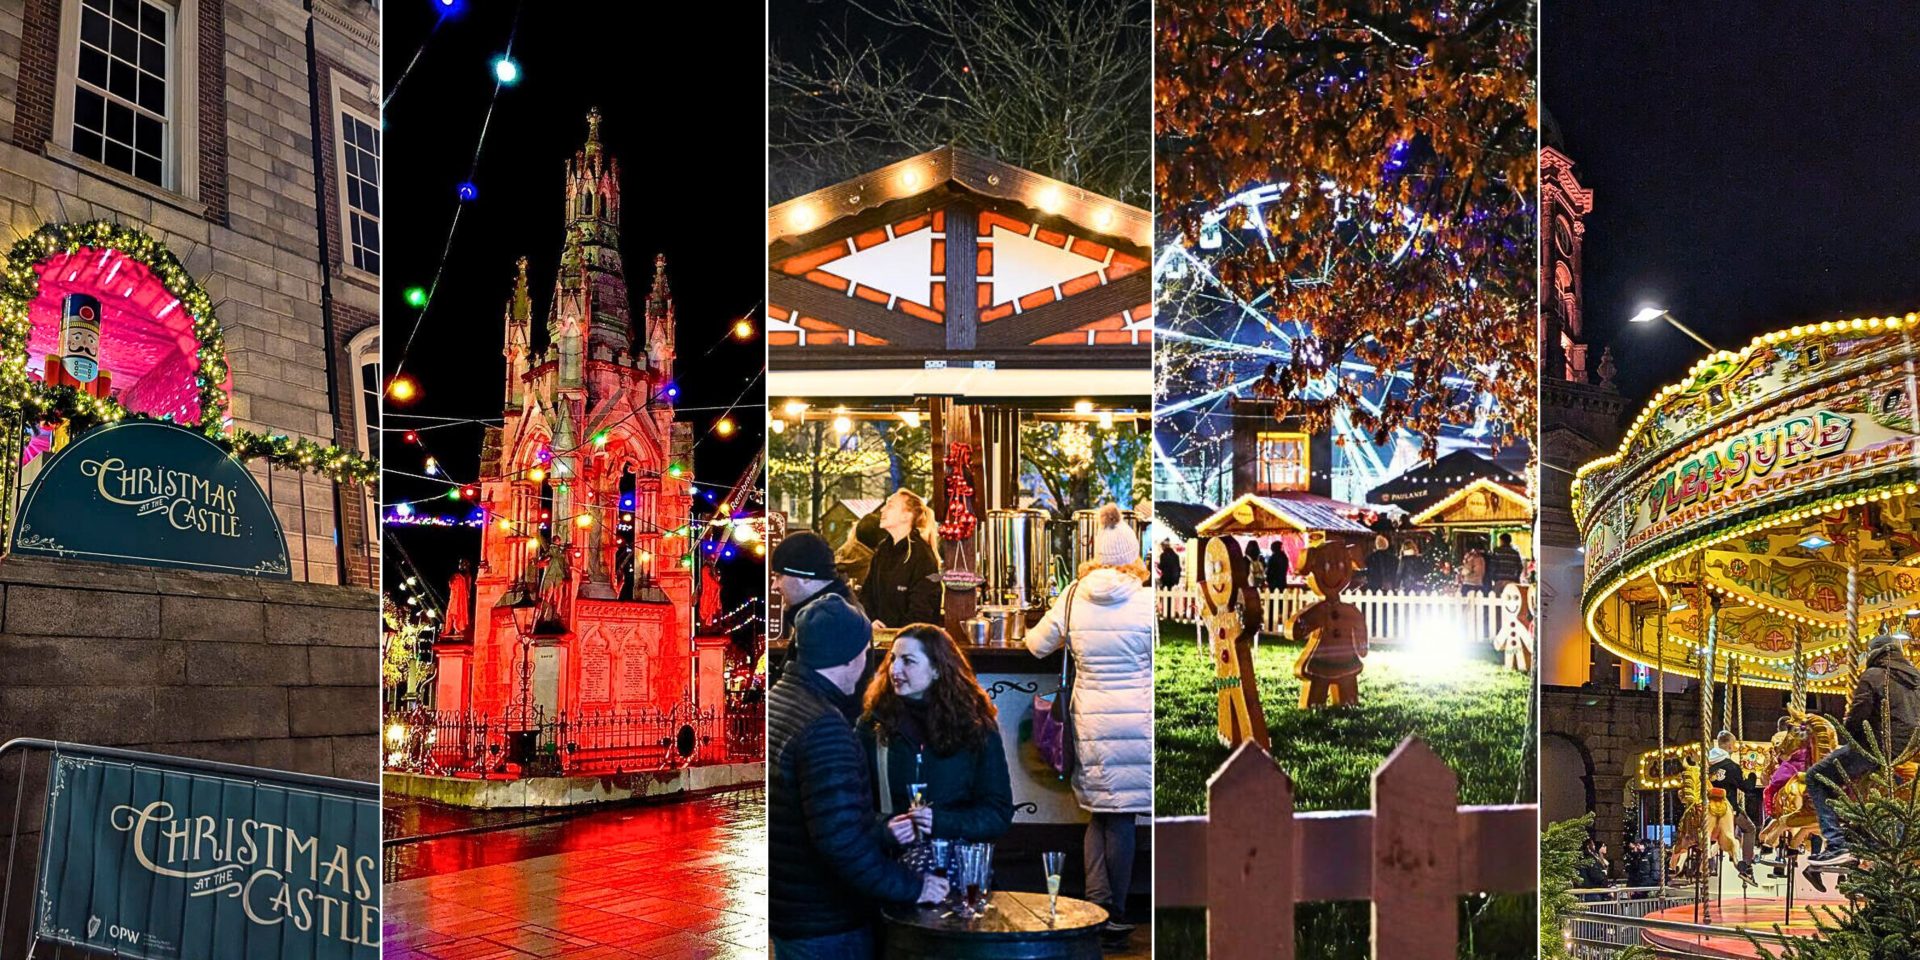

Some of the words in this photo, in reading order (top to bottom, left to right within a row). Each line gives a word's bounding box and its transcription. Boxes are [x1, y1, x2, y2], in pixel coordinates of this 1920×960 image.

[80, 458, 237, 514] CHRISTMAS
[1650, 410, 1853, 522] PLEASURE
[139, 503, 150, 512] AT
[151, 499, 164, 509] THE
[168, 498, 241, 538] CASTLE
[111, 801, 375, 901] CHRISTMAS
[193, 877, 211, 890] AT
[213, 870, 233, 886] THE
[243, 869, 380, 947] CASTLE
[109, 925, 140, 944] OPW
